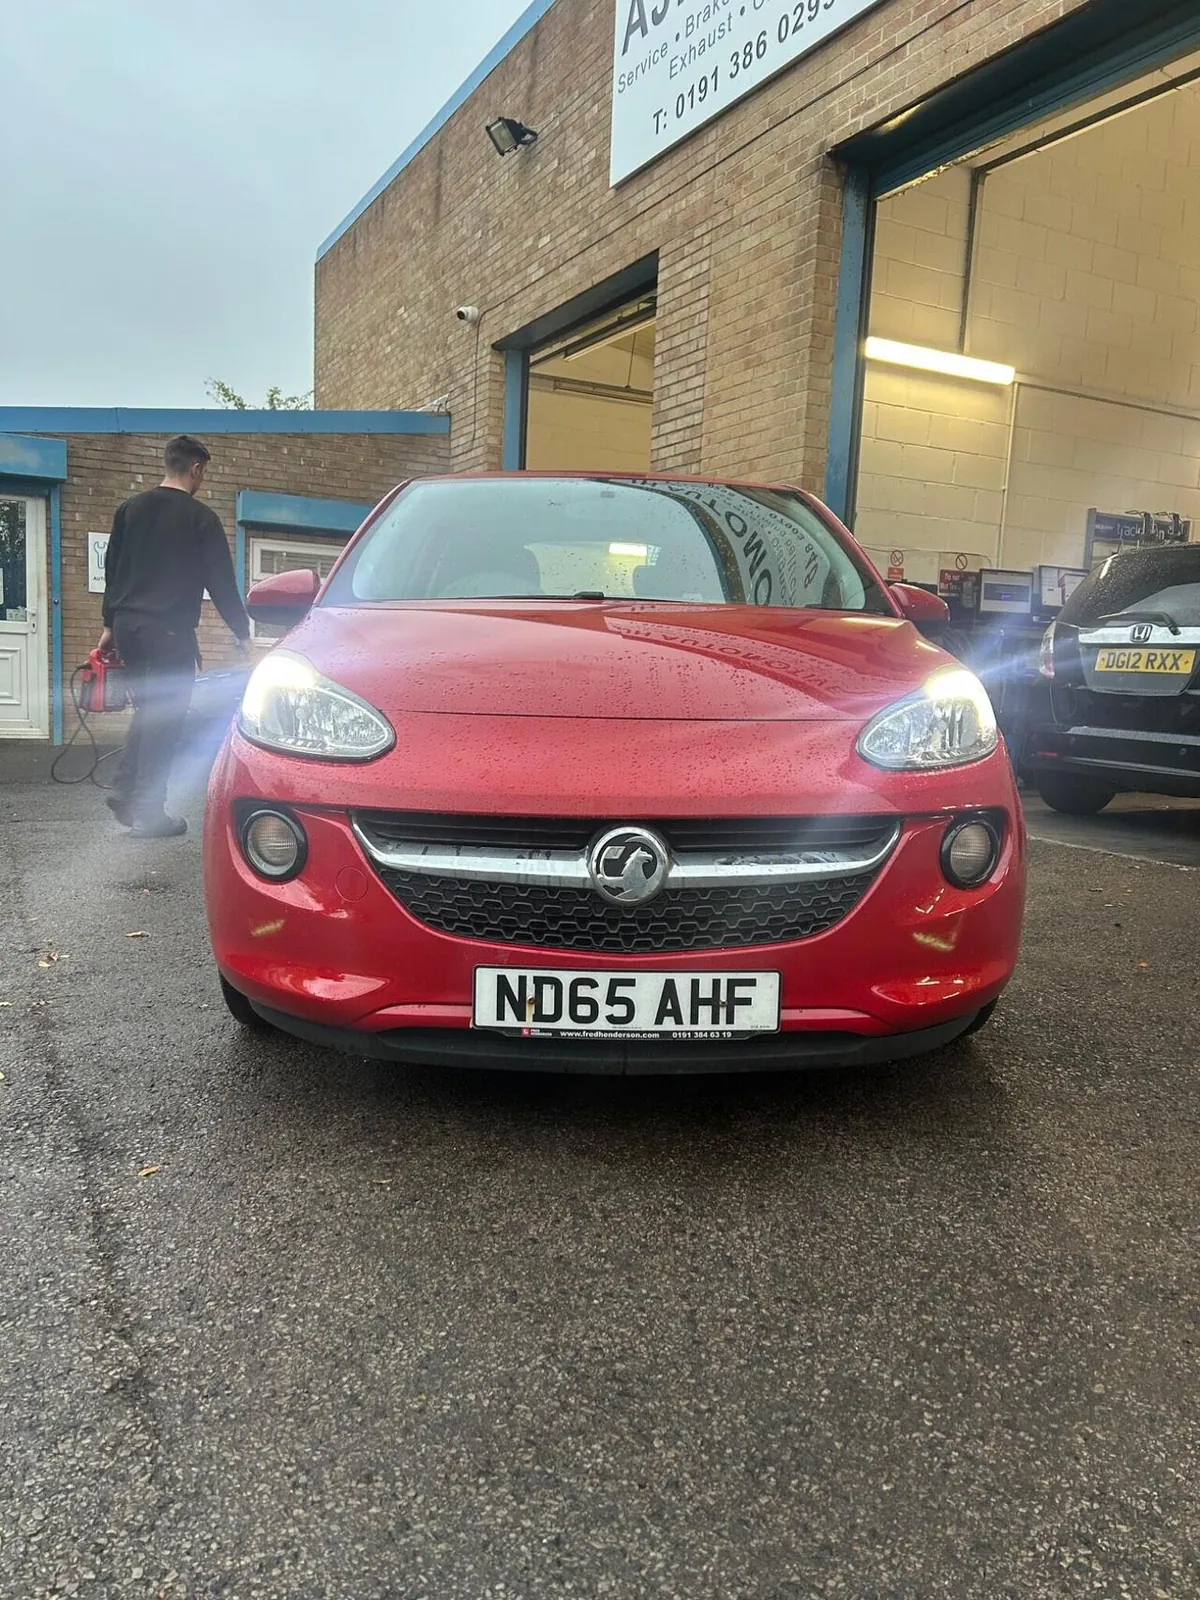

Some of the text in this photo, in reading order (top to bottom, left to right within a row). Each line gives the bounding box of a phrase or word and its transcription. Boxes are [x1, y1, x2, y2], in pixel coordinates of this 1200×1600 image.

[618, 42, 668, 94] Service
[669, 12, 733, 80] Exhaust
[653, 108, 668, 135] T:
[676, 66, 719, 119] 0191
[729, 30, 768, 79] 386
[1105, 652, 1183, 670] DG12 RXX
[496, 974, 757, 1025] ND65 AHF
[560, 1031, 660, 1039] www.fredhenderson.com
